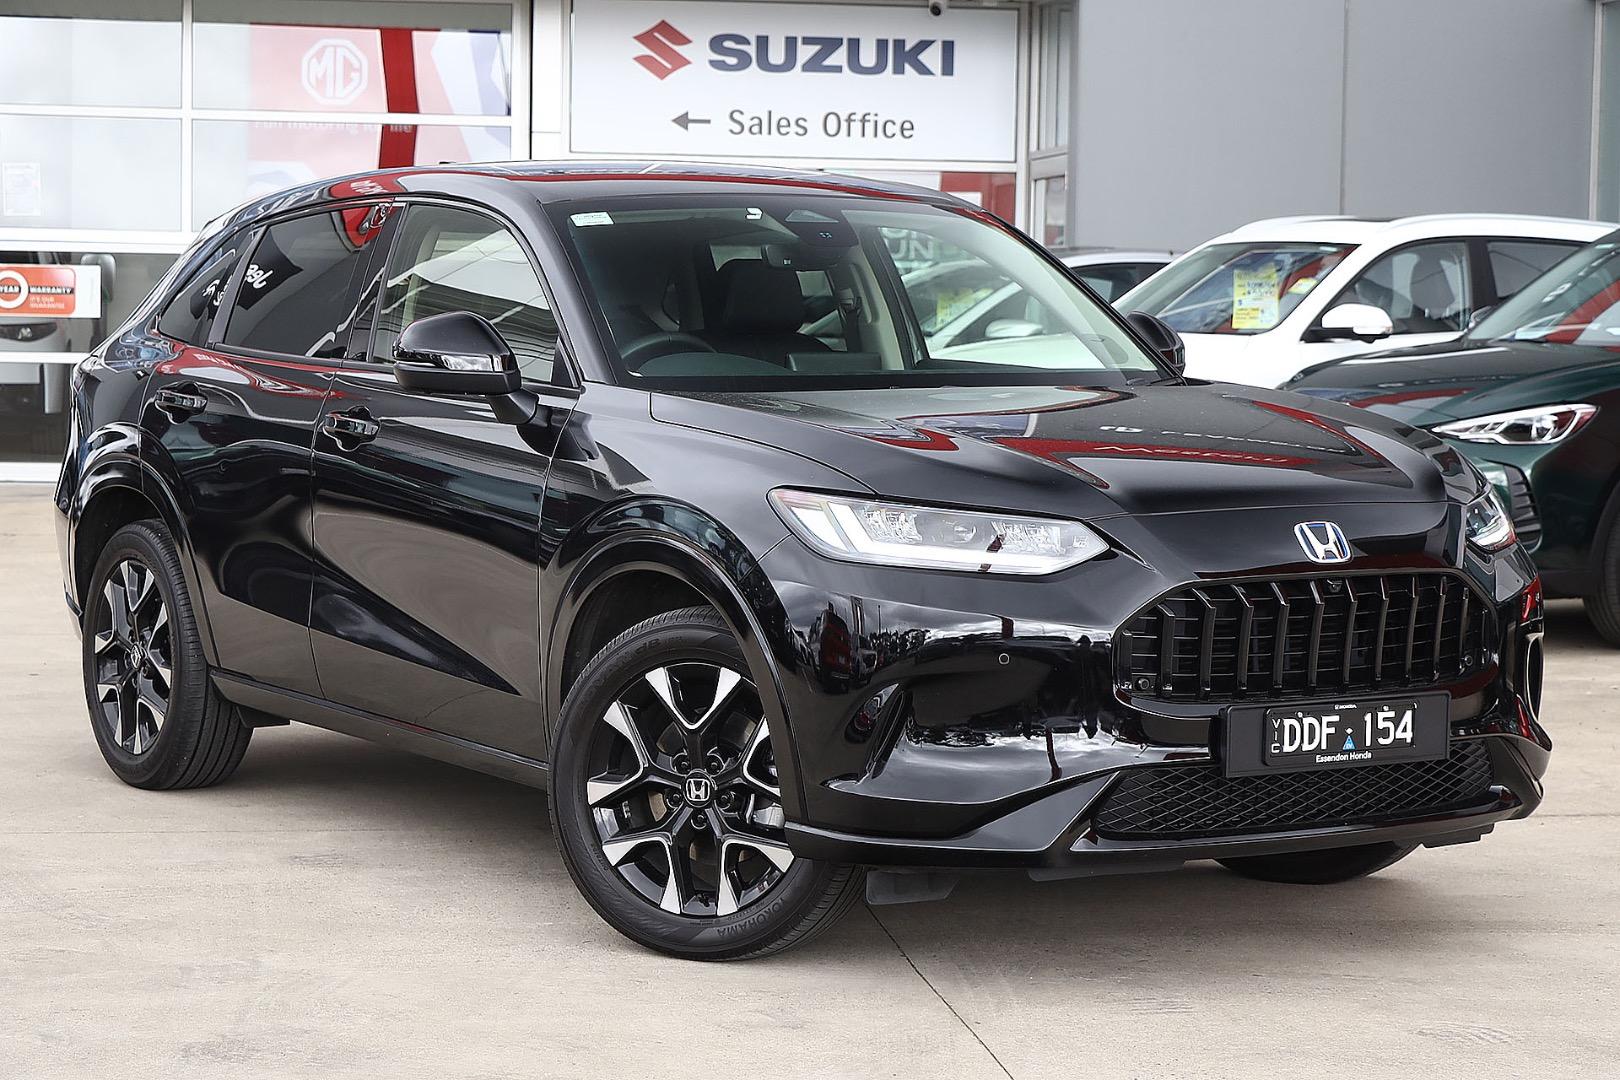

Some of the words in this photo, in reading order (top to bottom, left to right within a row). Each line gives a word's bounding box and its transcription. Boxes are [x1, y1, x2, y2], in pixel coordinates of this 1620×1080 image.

[308, 45, 362, 98] MG
[708, 33, 955, 77] SUZUKI
[728, 109, 808, 136] Sales
[822, 111, 915, 139] Office
[1283, 715, 1340, 753] DDF
[1364, 709, 1413, 747] 154
[1315, 753, 1348, 763] Essendon
[1349, 750, 1372, 760] Honda
